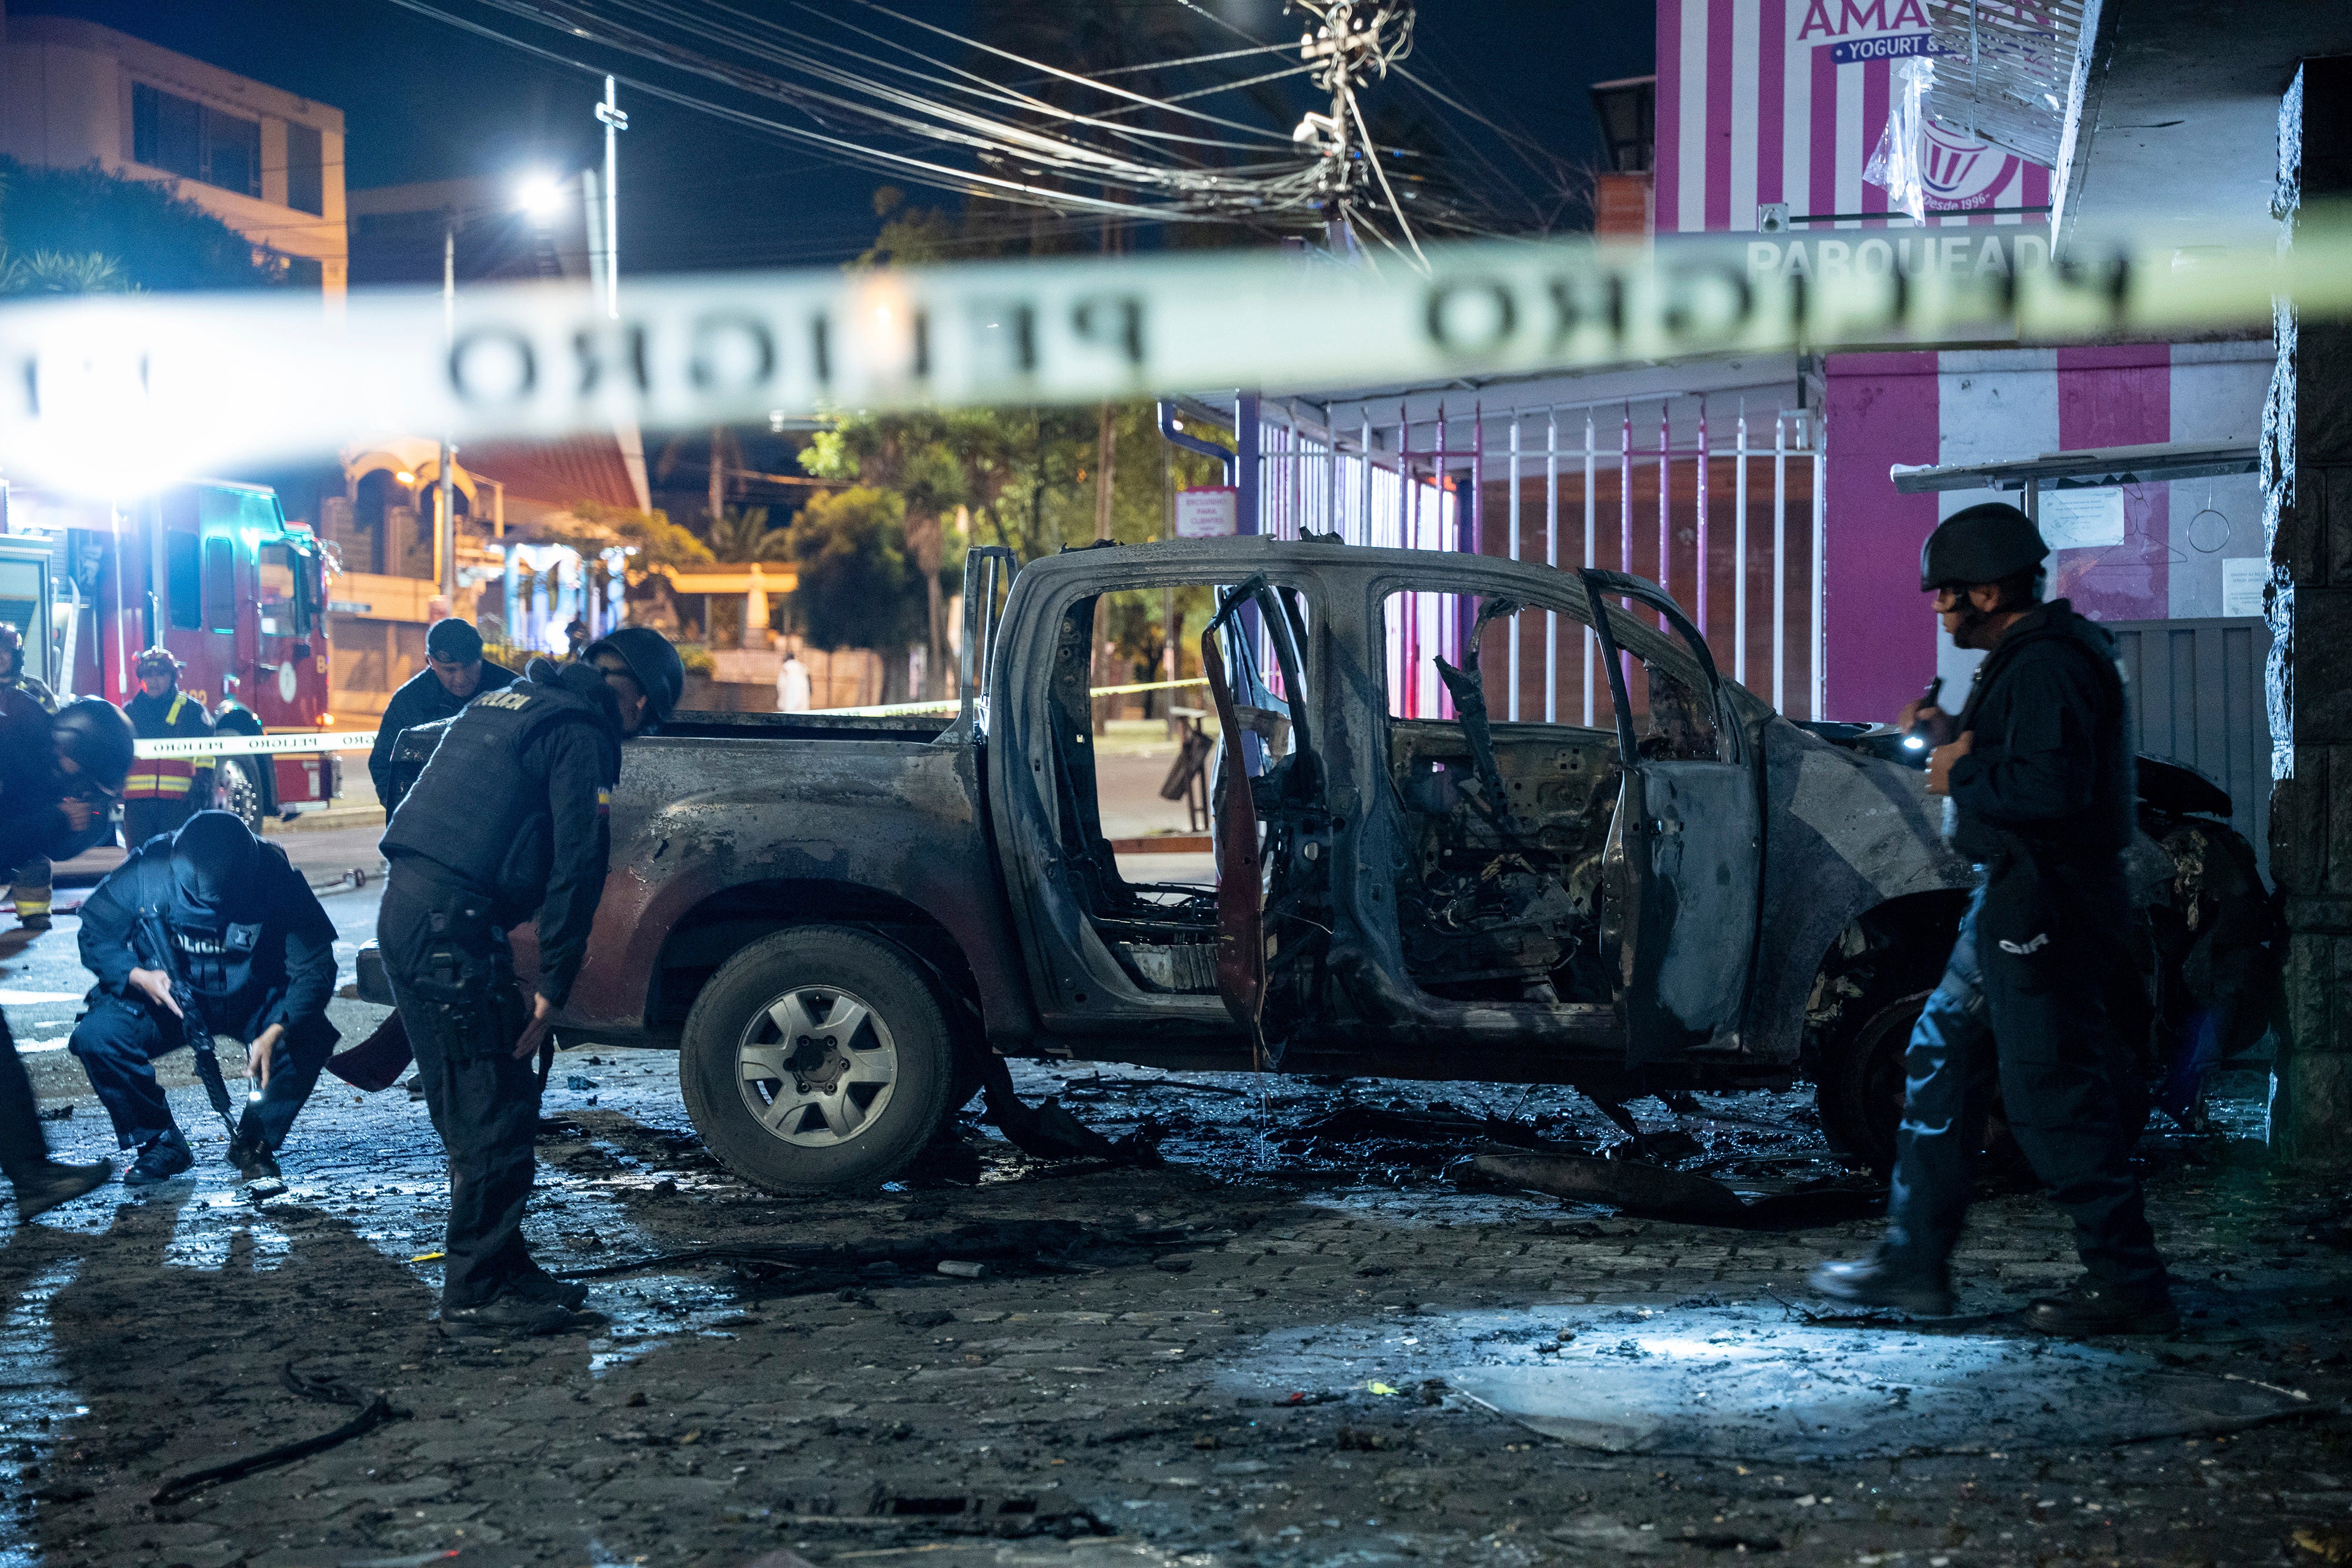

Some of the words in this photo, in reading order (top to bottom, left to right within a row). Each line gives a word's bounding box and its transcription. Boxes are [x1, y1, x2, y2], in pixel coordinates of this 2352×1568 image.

[1849, 36, 1922, 59] YOGURT
[1926, 36, 1940, 52] &
[1923, 194, 1959, 210] Desde
